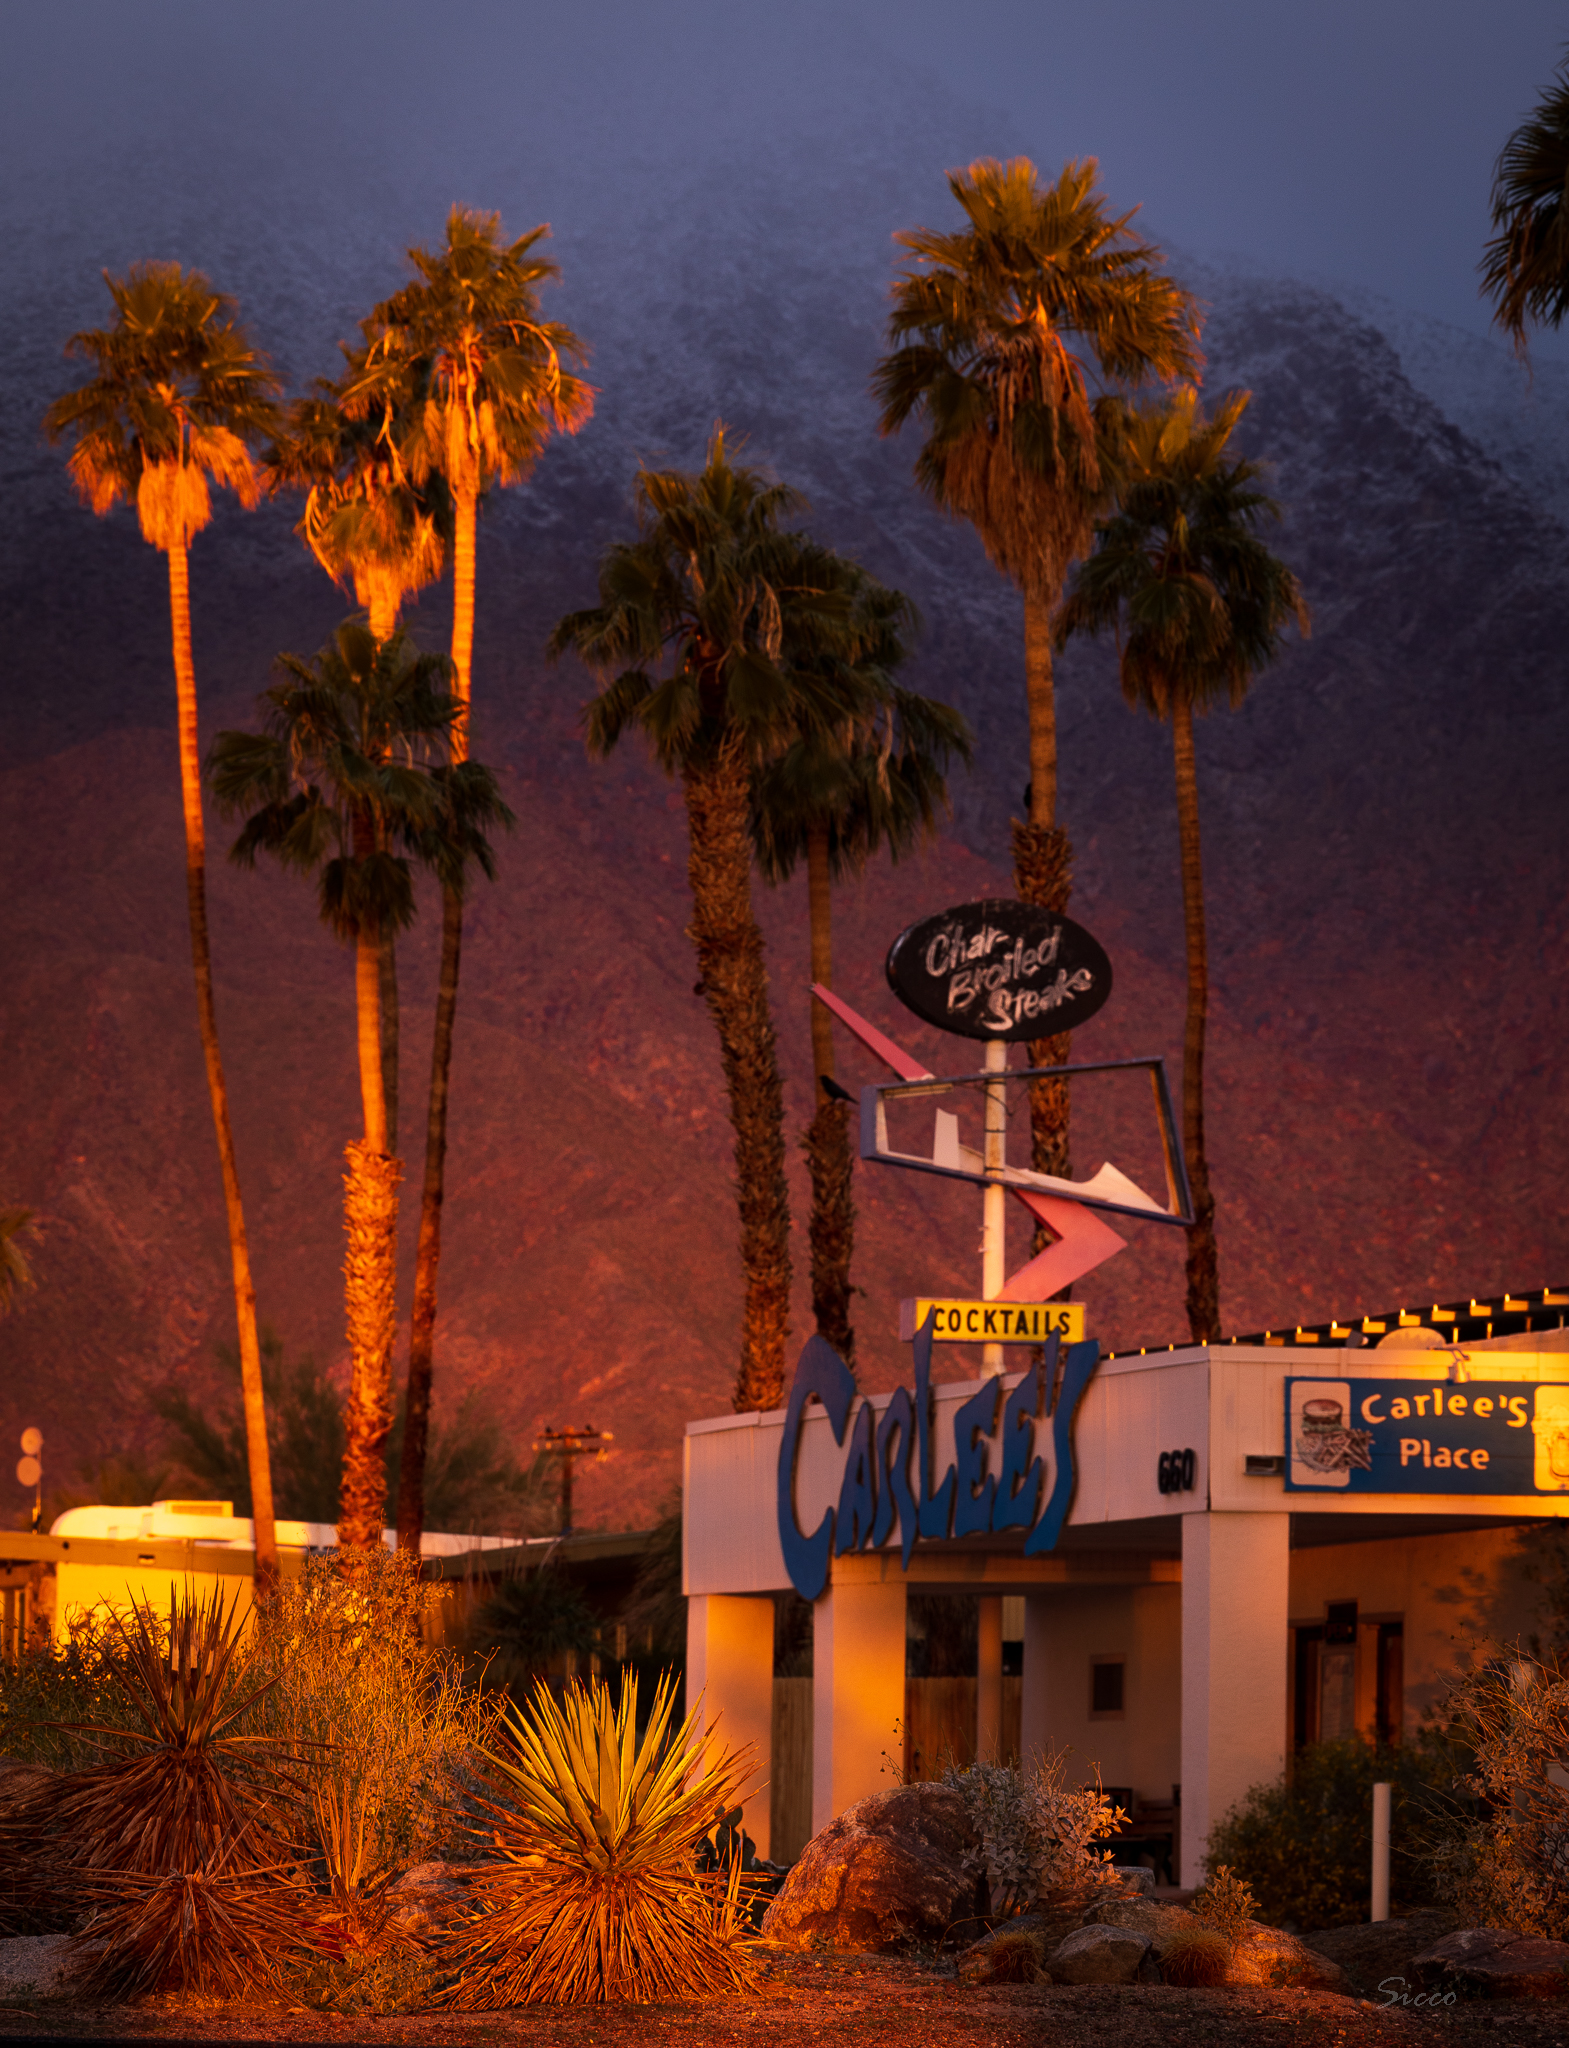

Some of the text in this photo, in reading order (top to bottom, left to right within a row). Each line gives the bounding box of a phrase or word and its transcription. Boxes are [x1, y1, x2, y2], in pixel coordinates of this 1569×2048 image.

[947, 924, 1063, 1013] Broiled
[978, 967, 1096, 1031] Steaks
[933, 1308, 1071, 1336] COCKTAILS
[1158, 1447, 1195, 1494] 660
[1400, 1438, 1491, 1470] Place
